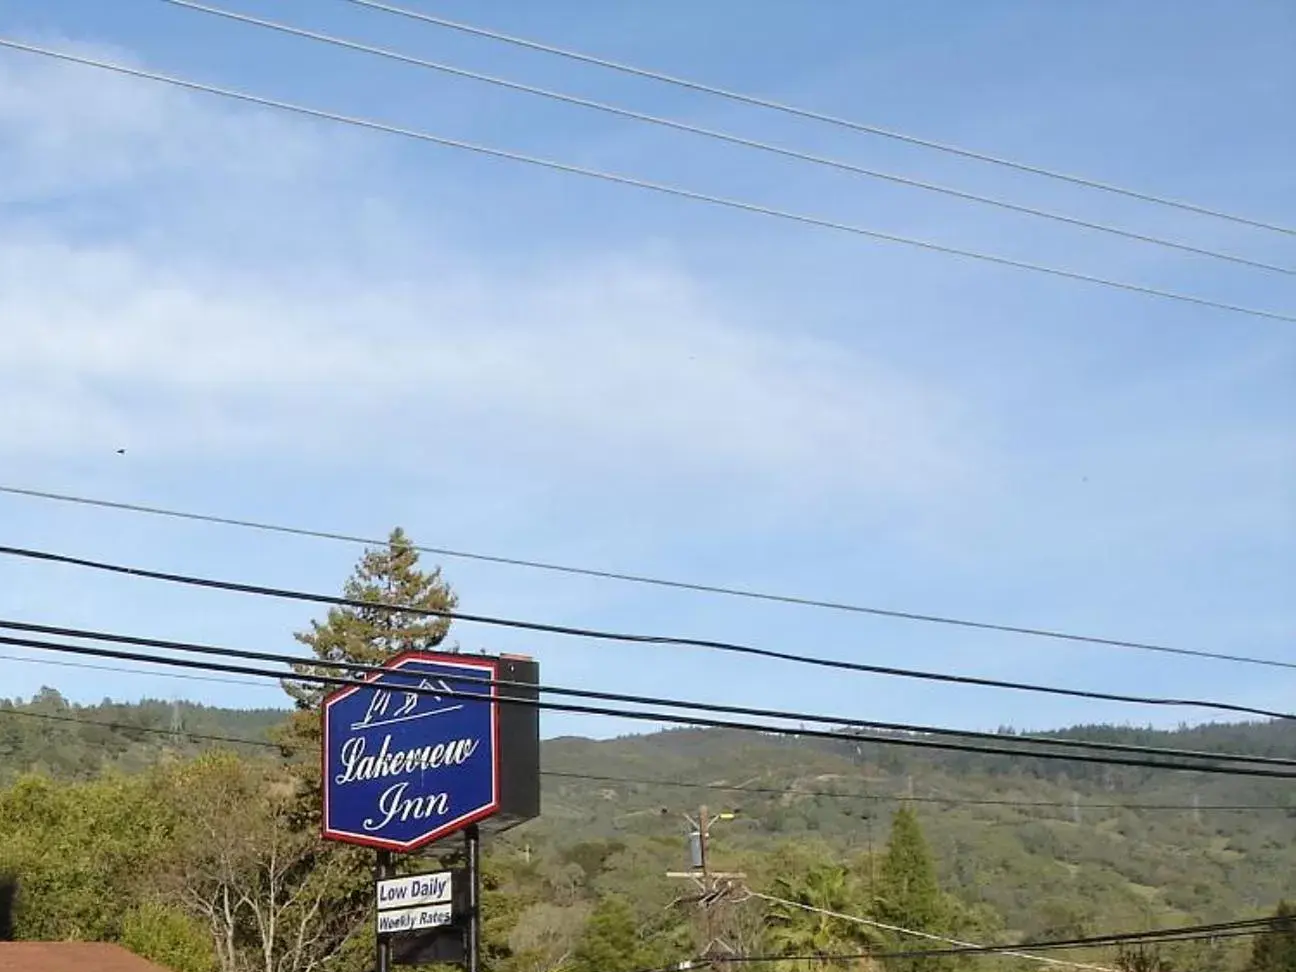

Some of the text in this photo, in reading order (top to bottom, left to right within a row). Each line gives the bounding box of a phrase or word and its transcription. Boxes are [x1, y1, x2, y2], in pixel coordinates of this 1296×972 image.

[335, 734, 479, 785] Lakeview
[363, 782, 449, 830] Inn
[380, 878, 447, 902] Low Daily
[380, 911, 451, 930] Weekly Rates
